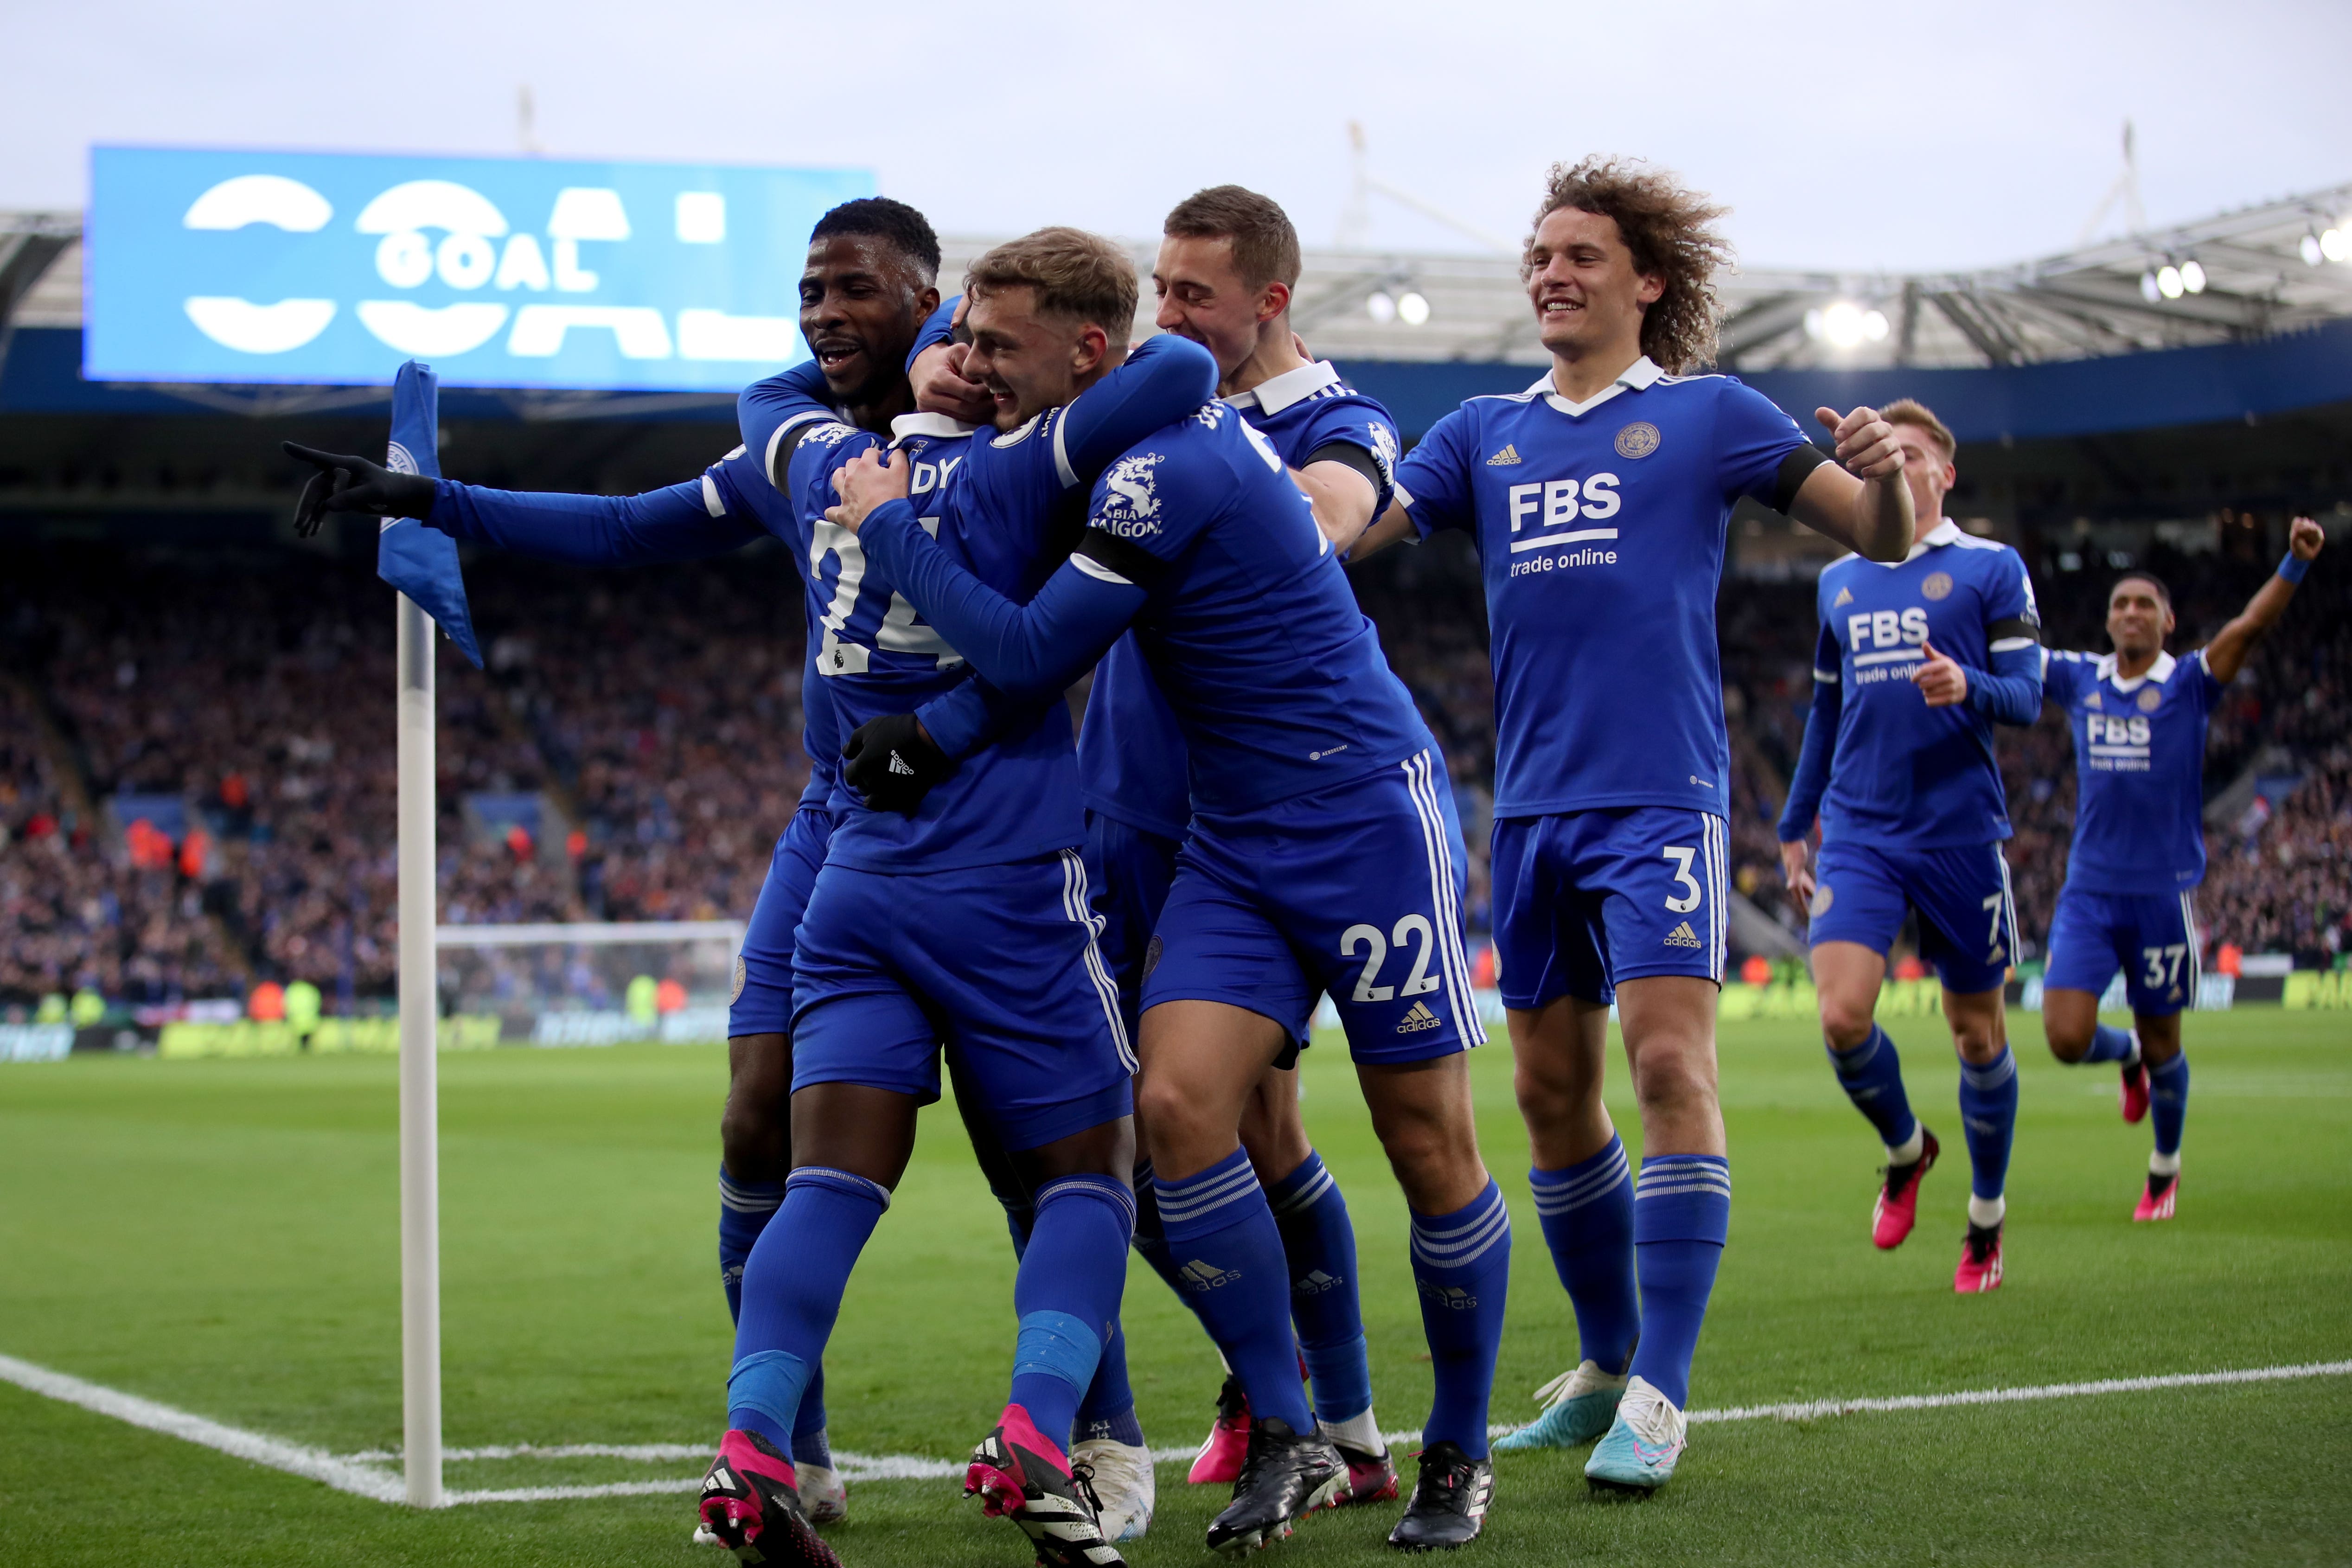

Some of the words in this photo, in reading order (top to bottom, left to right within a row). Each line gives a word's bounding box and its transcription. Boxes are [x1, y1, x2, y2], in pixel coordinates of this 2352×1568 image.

[376, 229, 599, 292] GOAL
[909, 456, 963, 495] DY
[1486, 456, 1521, 466] adidas
[1113, 509, 1138, 520] BIA
[1509, 472, 1621, 532] FBS
[1510, 556, 1553, 577] trade
[1558, 548, 1617, 569] online
[1847, 606, 1930, 652] FBS
[2087, 713, 2151, 746] FBS
[890, 749, 914, 775] adidas
[1663, 846, 1701, 914] 3
[1982, 890, 2003, 947] 7
[1340, 914, 1440, 1002] 22
[1664, 937, 1701, 949] adidas
[2143, 943, 2186, 989] 37
[1397, 1018, 1441, 1034] adidas
